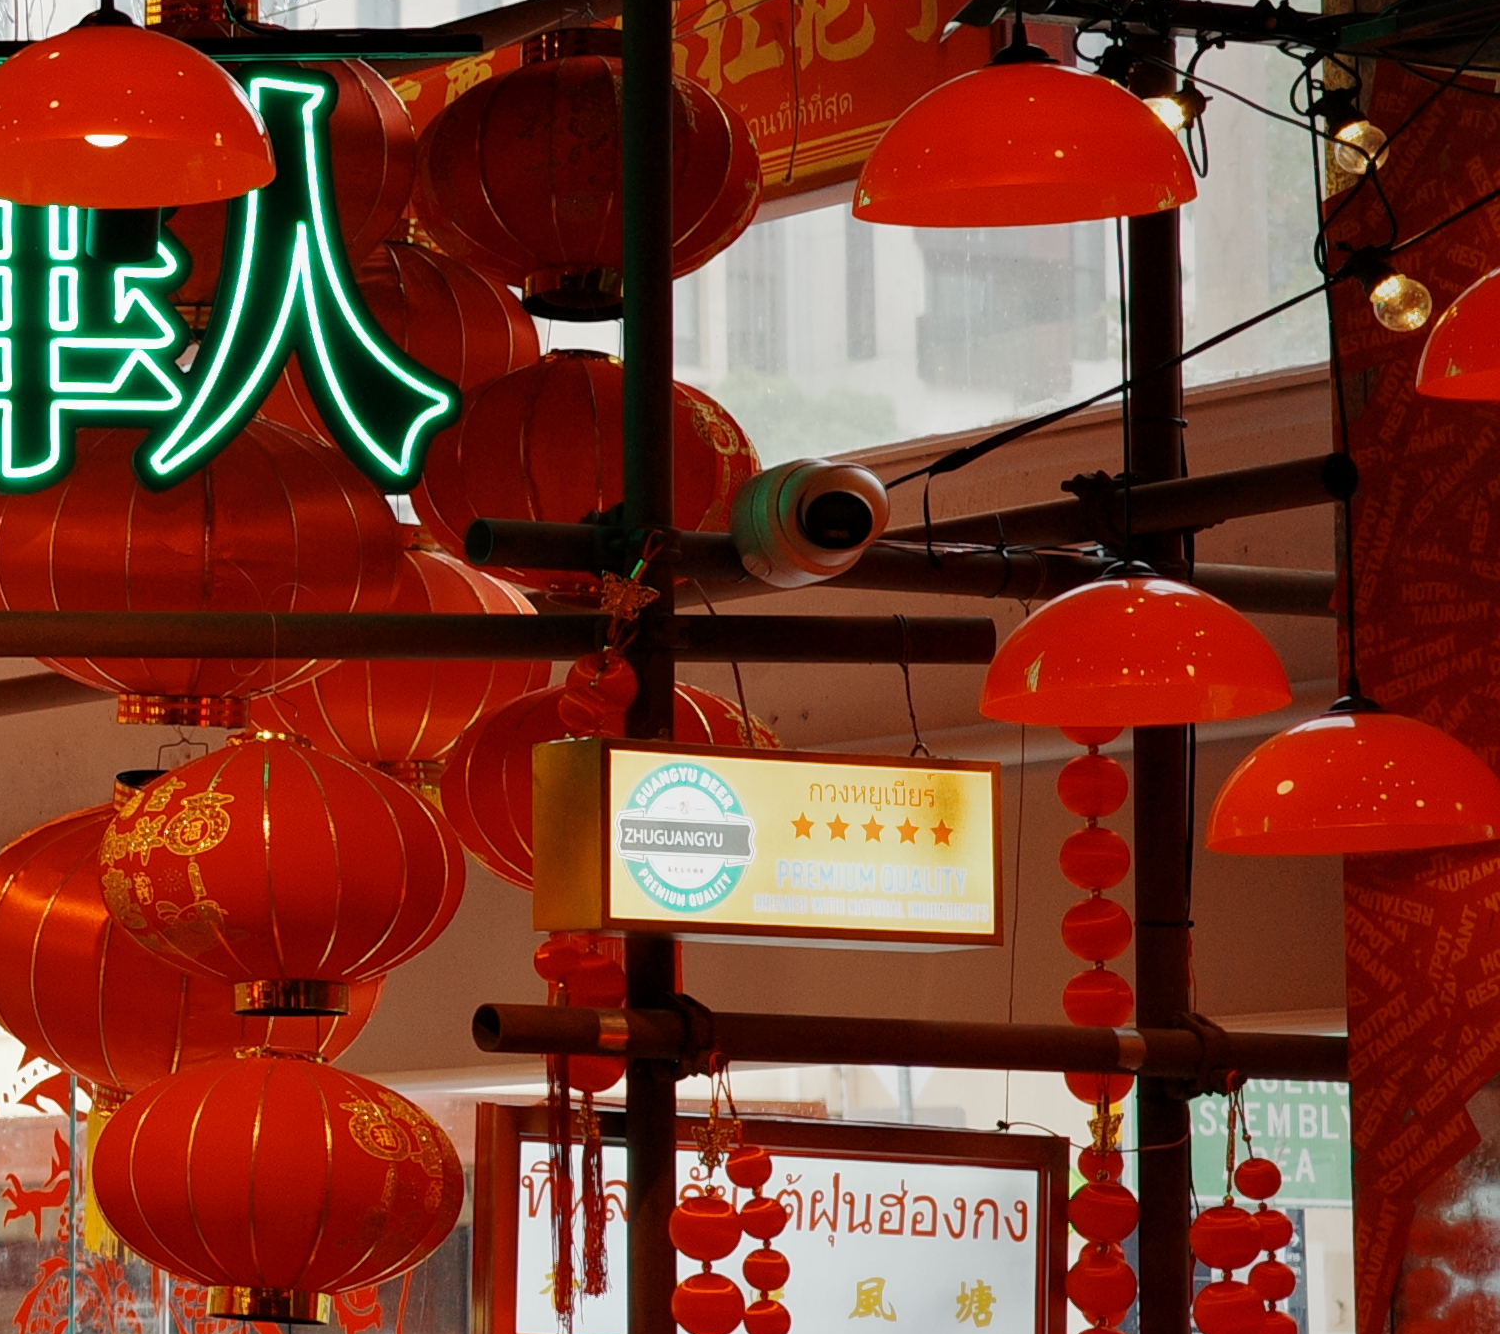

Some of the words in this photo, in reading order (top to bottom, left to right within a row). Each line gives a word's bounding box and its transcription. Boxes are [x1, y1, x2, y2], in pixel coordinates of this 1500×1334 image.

[623, 827, 724, 849] ZHUGUANGYU
[776, 859, 875, 892] PREMIUM
[880, 865, 968, 897] QUALITY
[1220, 1148, 1318, 1185] AEA
